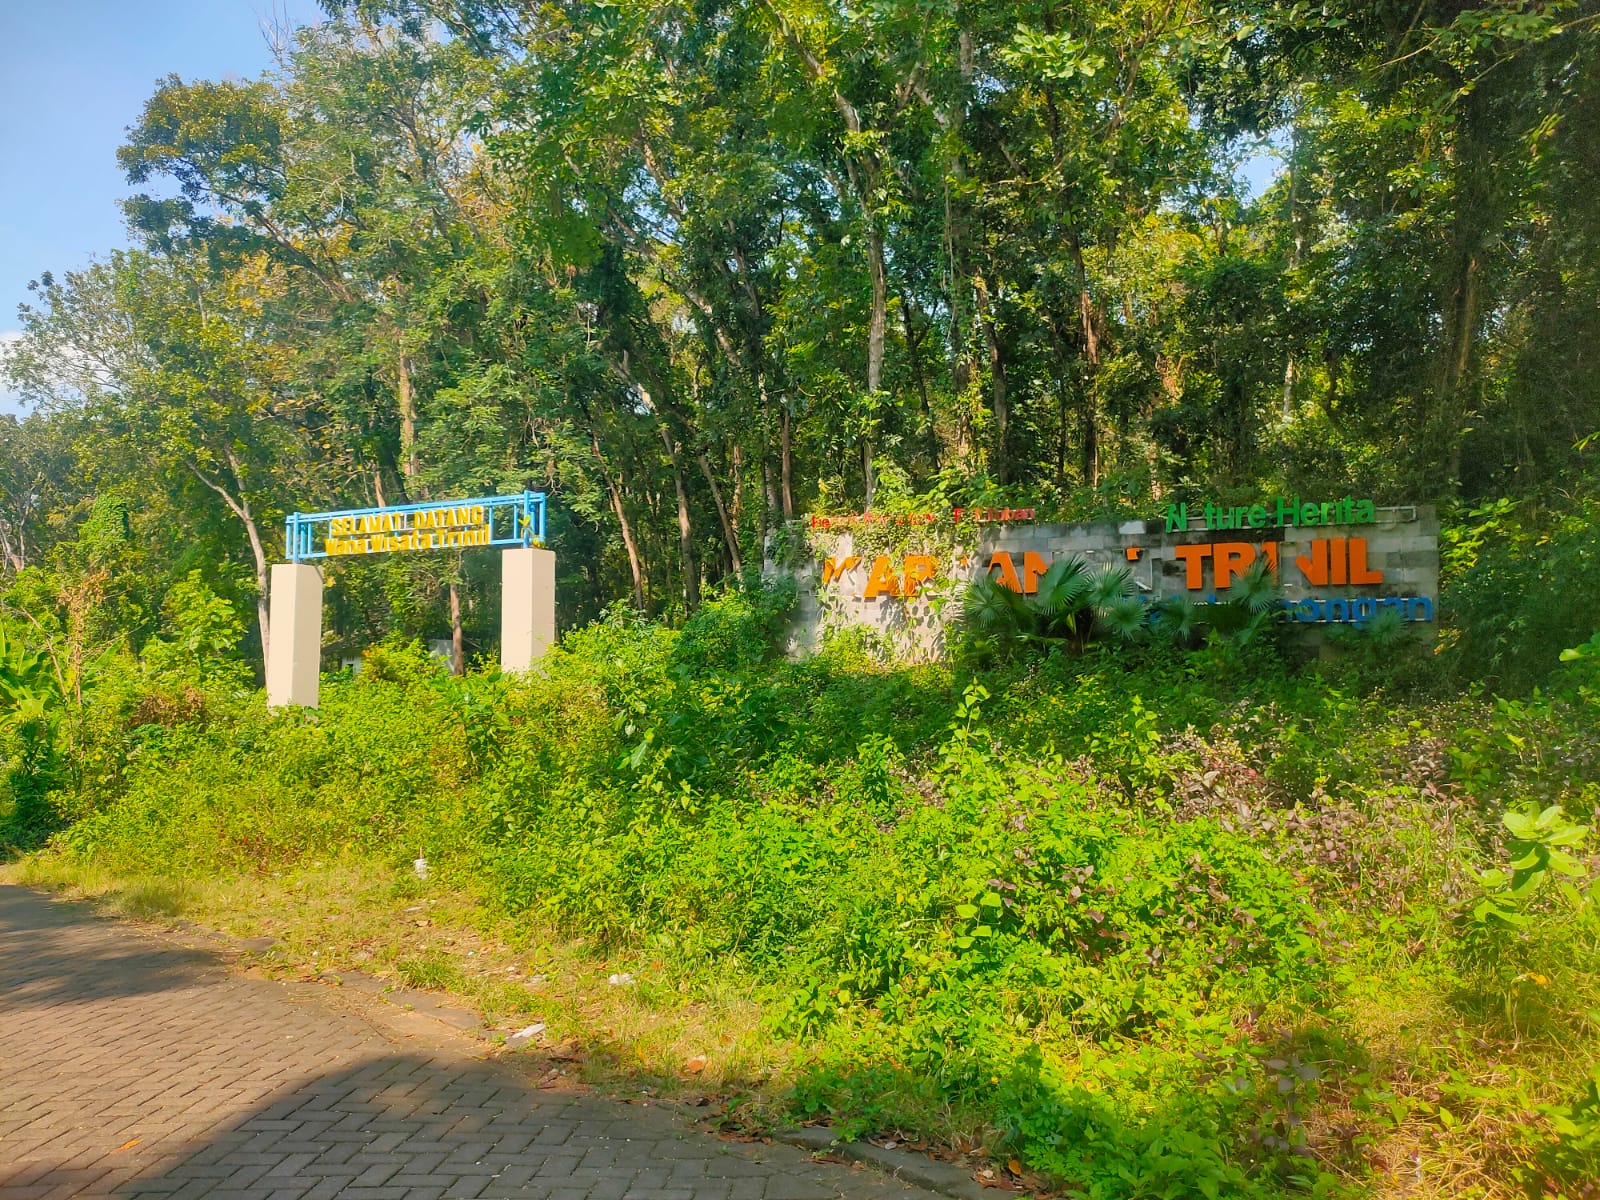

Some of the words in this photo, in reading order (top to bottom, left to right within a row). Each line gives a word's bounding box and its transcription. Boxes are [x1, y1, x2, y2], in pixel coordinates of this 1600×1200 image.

[330, 513, 404, 536] SELAMAT
[414, 506, 485, 529] DATANG
[1166, 502, 1266, 533] Nture
[325, 537, 367, 556] Wana
